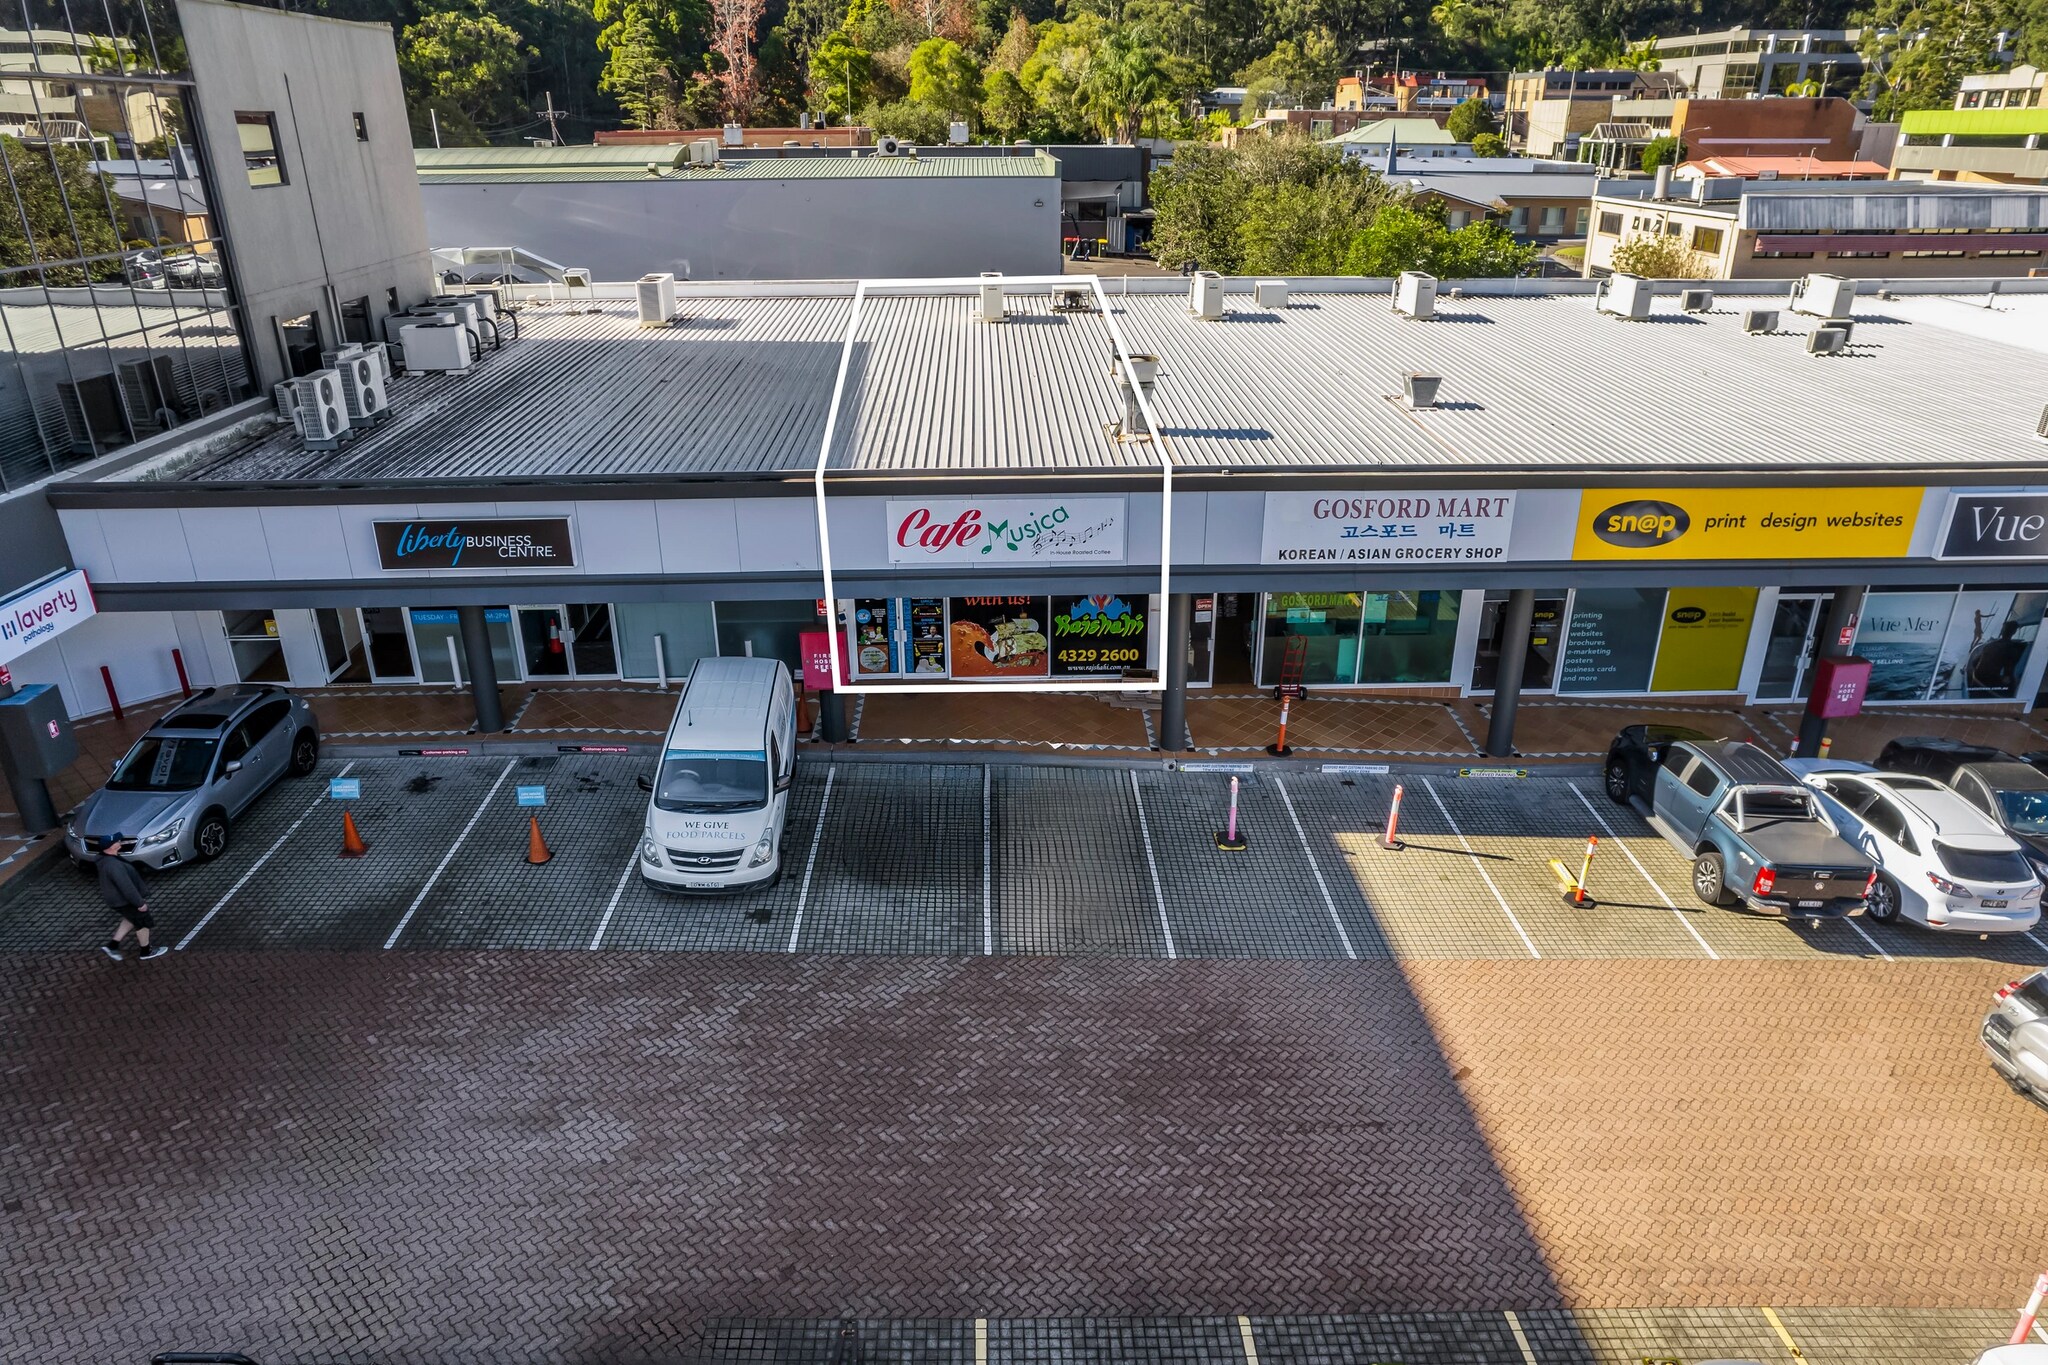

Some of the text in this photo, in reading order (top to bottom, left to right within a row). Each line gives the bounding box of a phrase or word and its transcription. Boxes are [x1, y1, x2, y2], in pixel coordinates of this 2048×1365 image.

[1313, 497, 1510, 520] GOSFORD MART
[1607, 513, 1676, 538] sn@p
[1704, 511, 1903, 532] print design websites
[1972, 506, 2046, 542] Vue
[981, 505, 1070, 555] Musica
[1340, 522, 1476, 539] 고스포드 마트
[466, 535, 532, 547] BUSINESS
[498, 546, 557, 558] CENTRE.
[1278, 547, 1503, 560] KOREAN / ASIAN GROCERY SHOP
[1281, 594, 1327, 607] GOSFORD
[15, 589, 78, 632] laverty
[1572, 612, 1603, 620] printing
[1871, 616, 1940, 632] Vue Mer
[23, 622, 54, 644] pathology
[1058, 648, 1139, 662] 4329 2600
[701, 831, 746, 840] PARCELS
